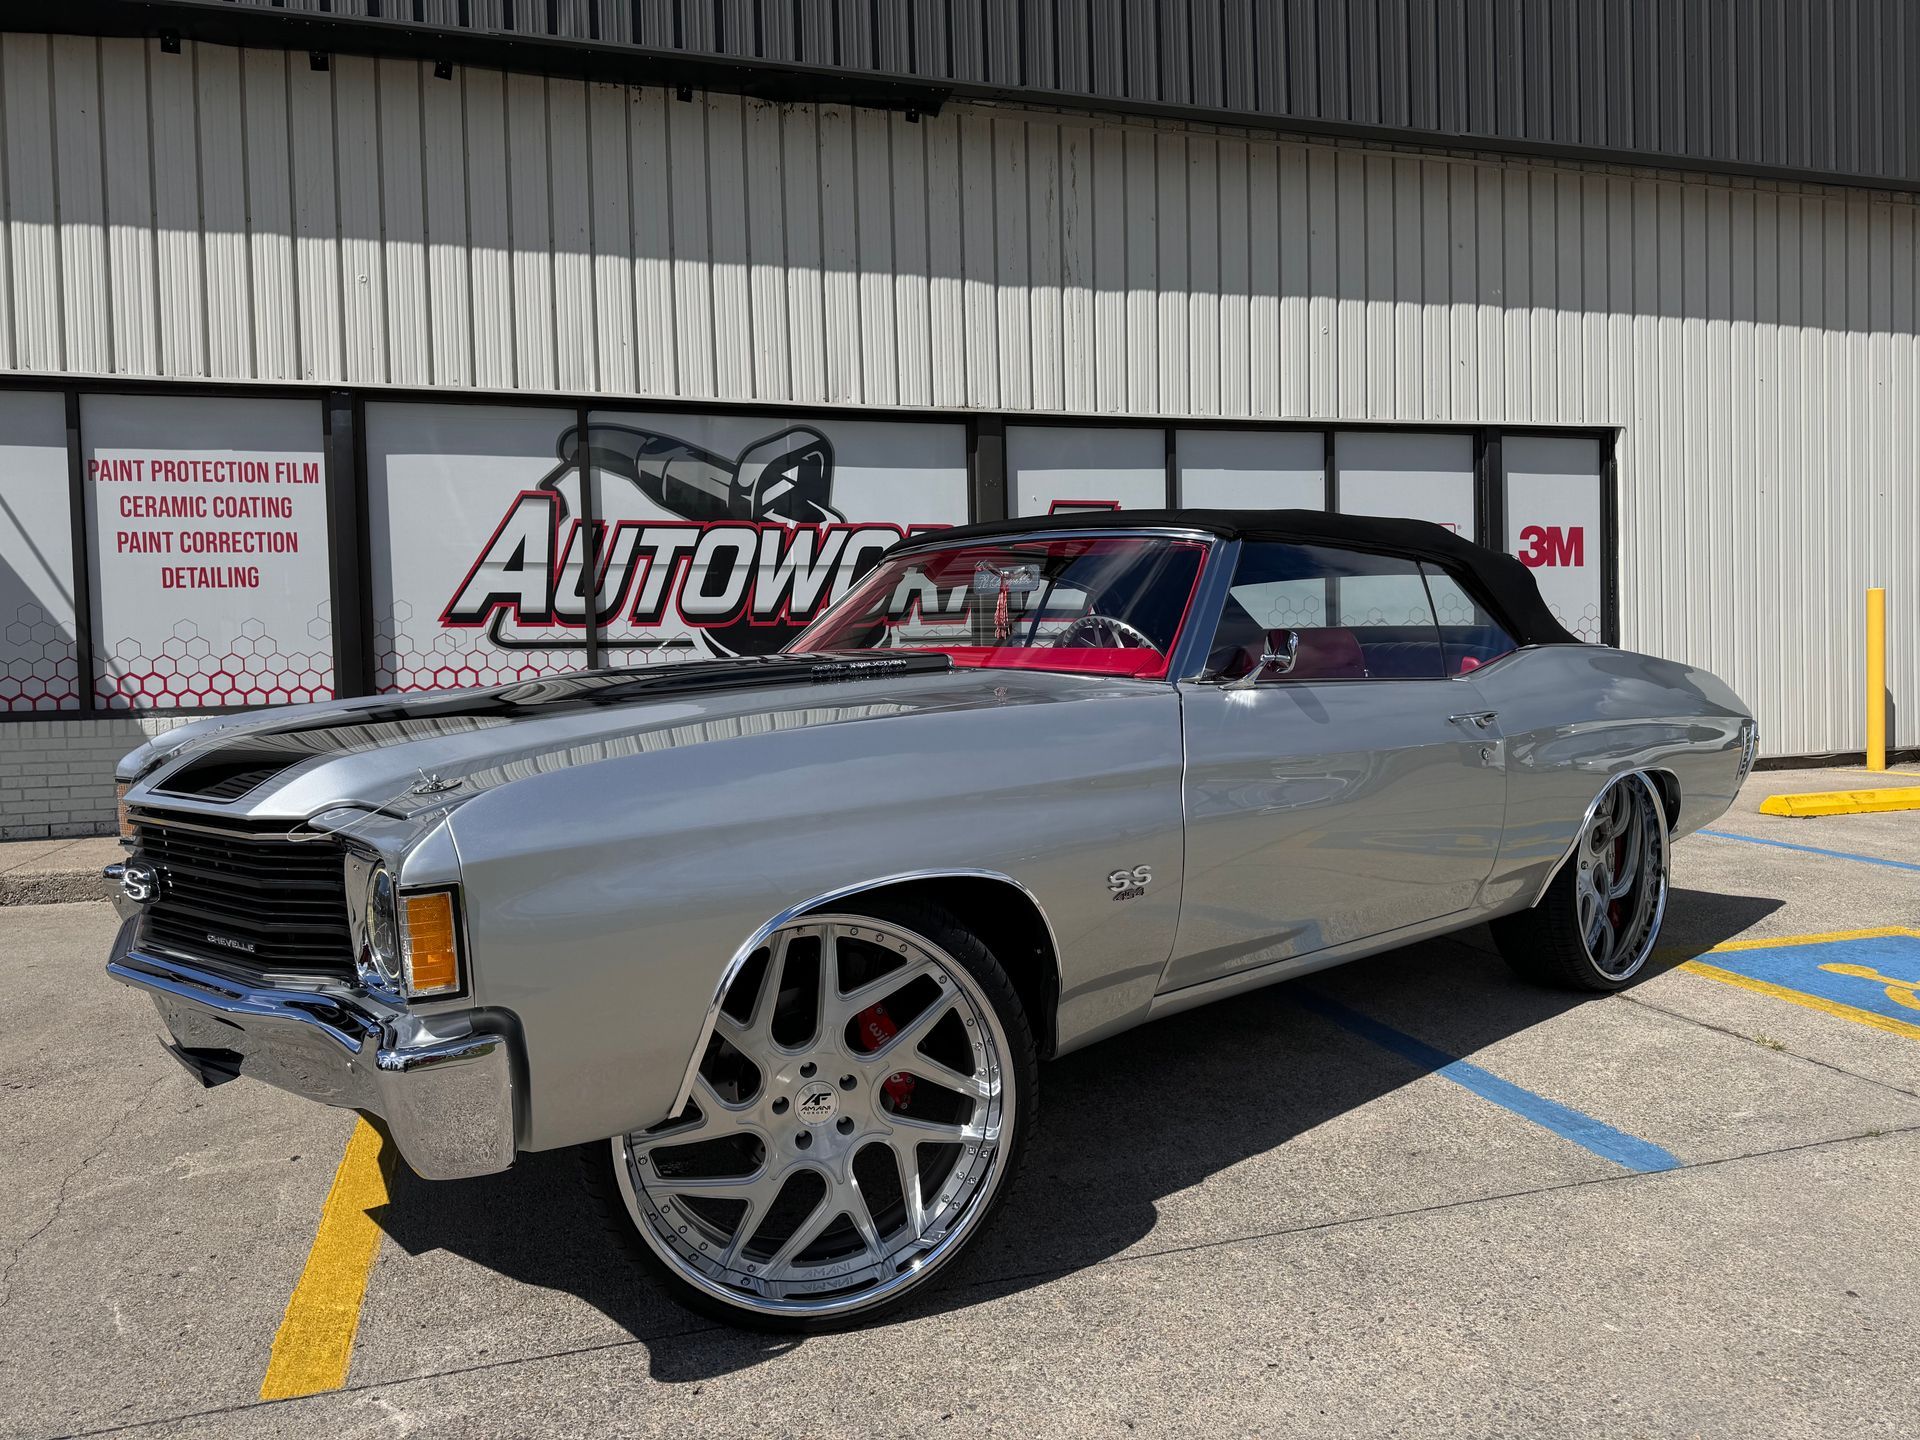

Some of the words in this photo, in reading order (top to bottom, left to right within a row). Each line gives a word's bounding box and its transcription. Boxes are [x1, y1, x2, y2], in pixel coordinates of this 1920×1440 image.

[88, 460, 144, 482] PAINT
[151, 461, 270, 483] PROTECTION
[275, 462, 320, 484] FILM
[120, 496, 207, 518] CERAMIC
[213, 496, 293, 518] COATING
[117, 531, 173, 553] PAINT
[180, 531, 298, 553] CORRECTION
[1518, 525, 1584, 568] 3M
[438, 490, 1117, 628] AUTOWOR
[162, 567, 260, 589] DETAILING
[1108, 864, 1152, 892] SS
[206, 934, 255, 953] CHEVELLE
